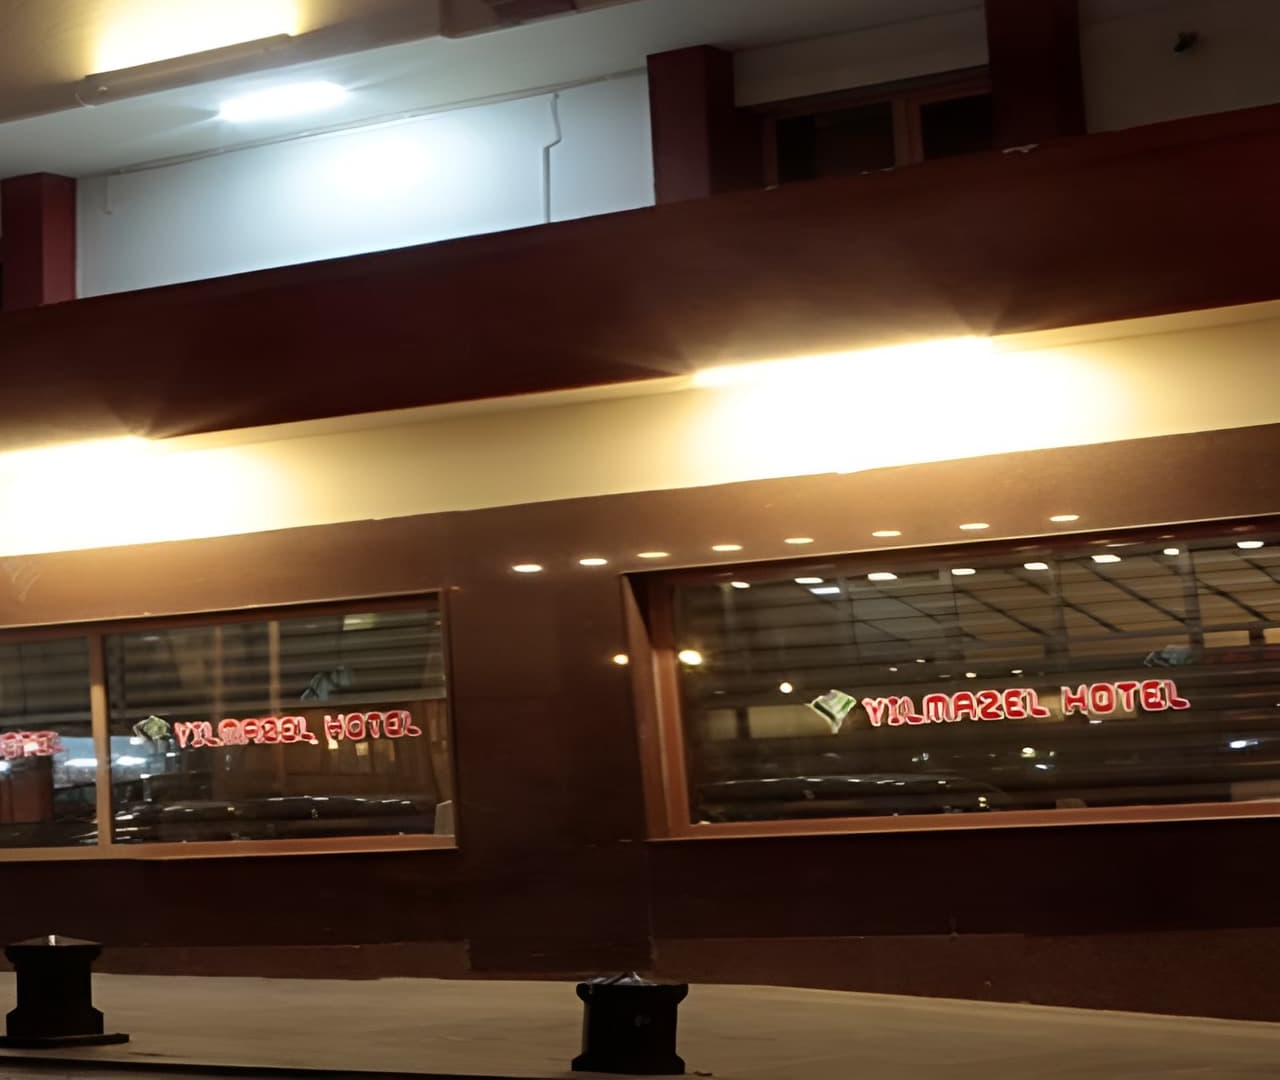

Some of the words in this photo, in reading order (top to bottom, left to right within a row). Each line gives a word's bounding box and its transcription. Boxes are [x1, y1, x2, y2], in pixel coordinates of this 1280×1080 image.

[861, 688, 1051, 727] YILMAZEL
[1060, 679, 1191, 715] HOTEL
[173, 716, 319, 749] YILMAZEL
[323, 710, 422, 741] HOTEL
